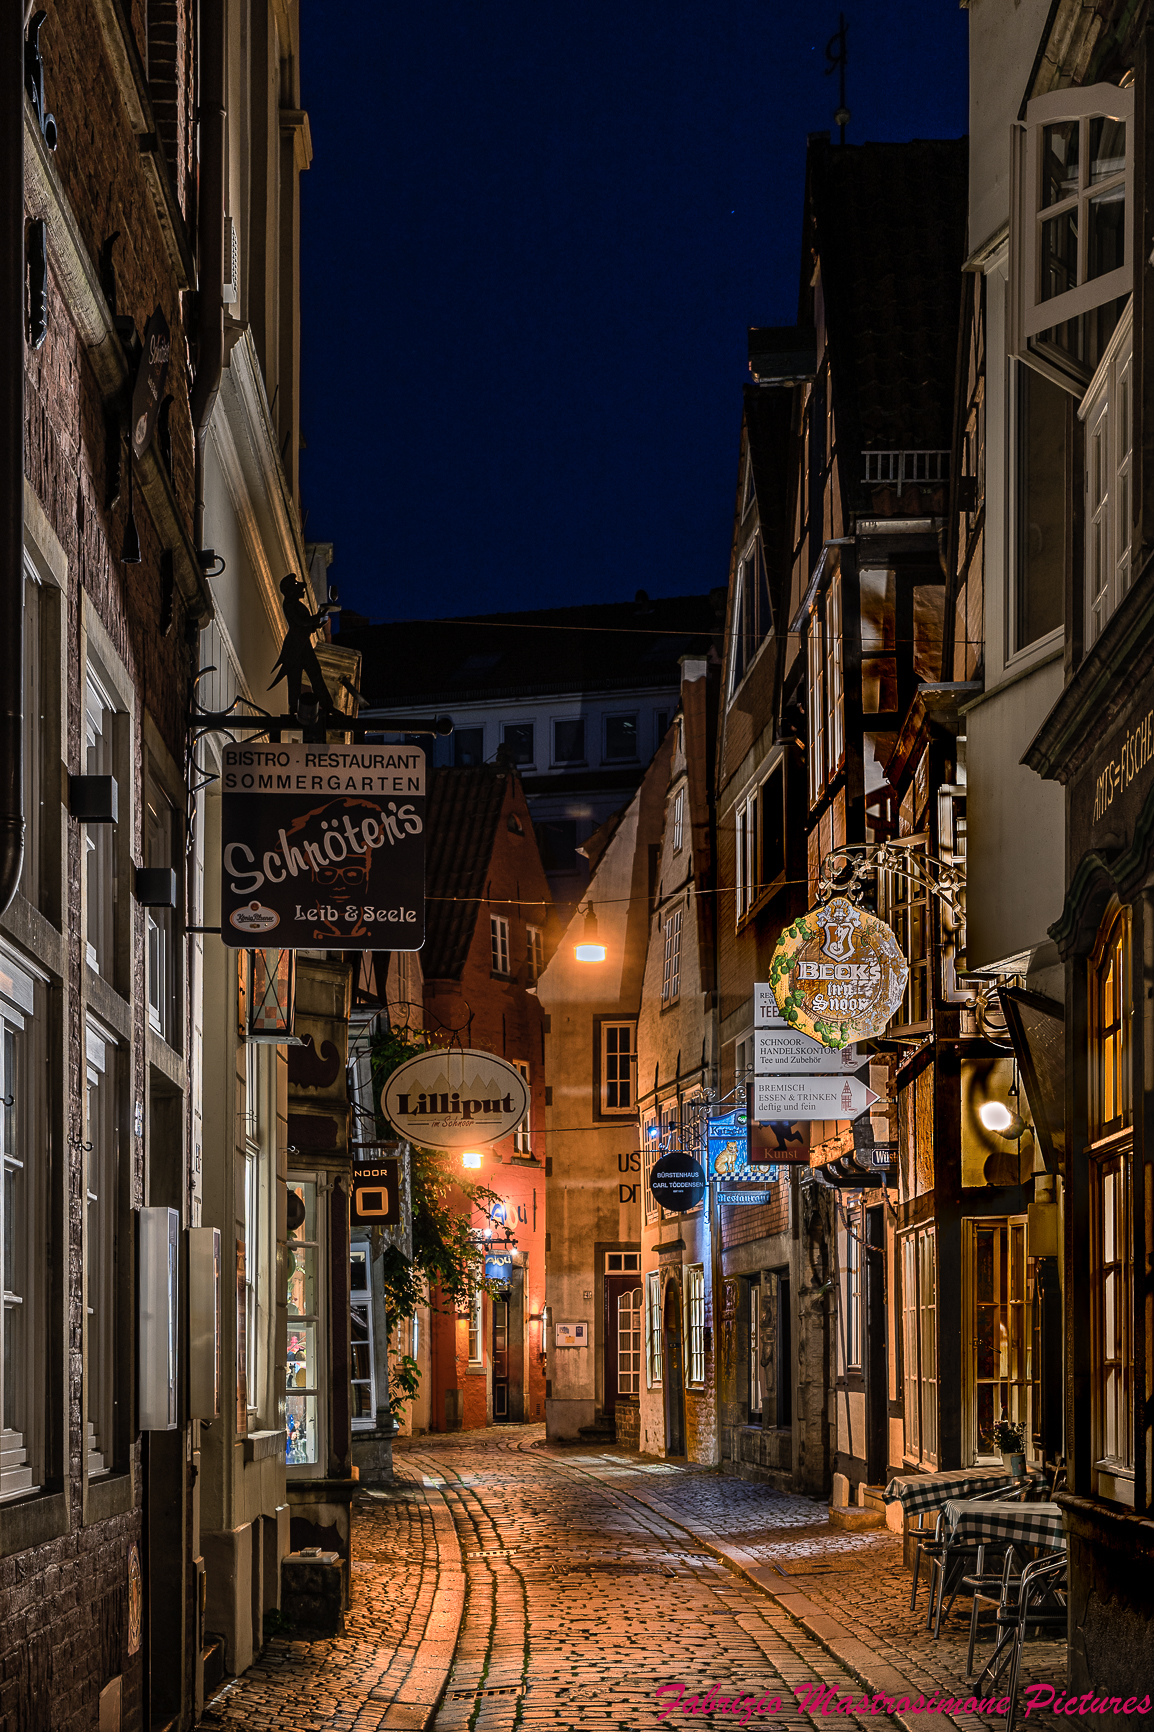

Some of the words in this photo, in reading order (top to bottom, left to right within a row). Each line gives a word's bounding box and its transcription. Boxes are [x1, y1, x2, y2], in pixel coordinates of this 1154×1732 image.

[226, 751, 290, 767] BISTRO
[305, 753, 420, 769] RESTAURANT
[225, 773, 420, 791] SOMMERGARTEN
[224, 801, 423, 895] Schröter's
[294, 904, 339, 922] Leib
[344, 905, 359, 922] &
[362, 906, 417, 923] Seele
[812, 993, 868, 1011] Snoor
[760, 1006, 779, 1018] TEE
[760, 1038, 804, 1046] SCHNOOR-
[760, 1047, 836, 1055] HANDELSKONTOR
[760, 1056, 773, 1064] Tee
[775, 1056, 788, 1064] und
[790, 1056, 821, 1064] Zubehör
[758, 1084, 805, 1092] BREMISCH
[758, 1094, 787, 1102] ESSEN
[797, 1093, 837, 1101] TRINKEN
[396, 1092, 516, 1120] Lilliput
[758, 1102, 782, 1113] deftig
[784, 1103, 799, 1111] und
[801, 1102, 816, 1111] fein
[431, 1118, 440, 1128] im
[442, 1115, 475, 1128] Schnoor
[711, 1126, 746, 1136] Katzen
[764, 1148, 798, 1159] Kunst
[876, 1150, 899, 1164] Wüst
[354, 1169, 388, 1177] NOOR
[656, 1171, 699, 1179] BÜRSTENHAUS
[717, 1193, 770, 1203] Restaurant
